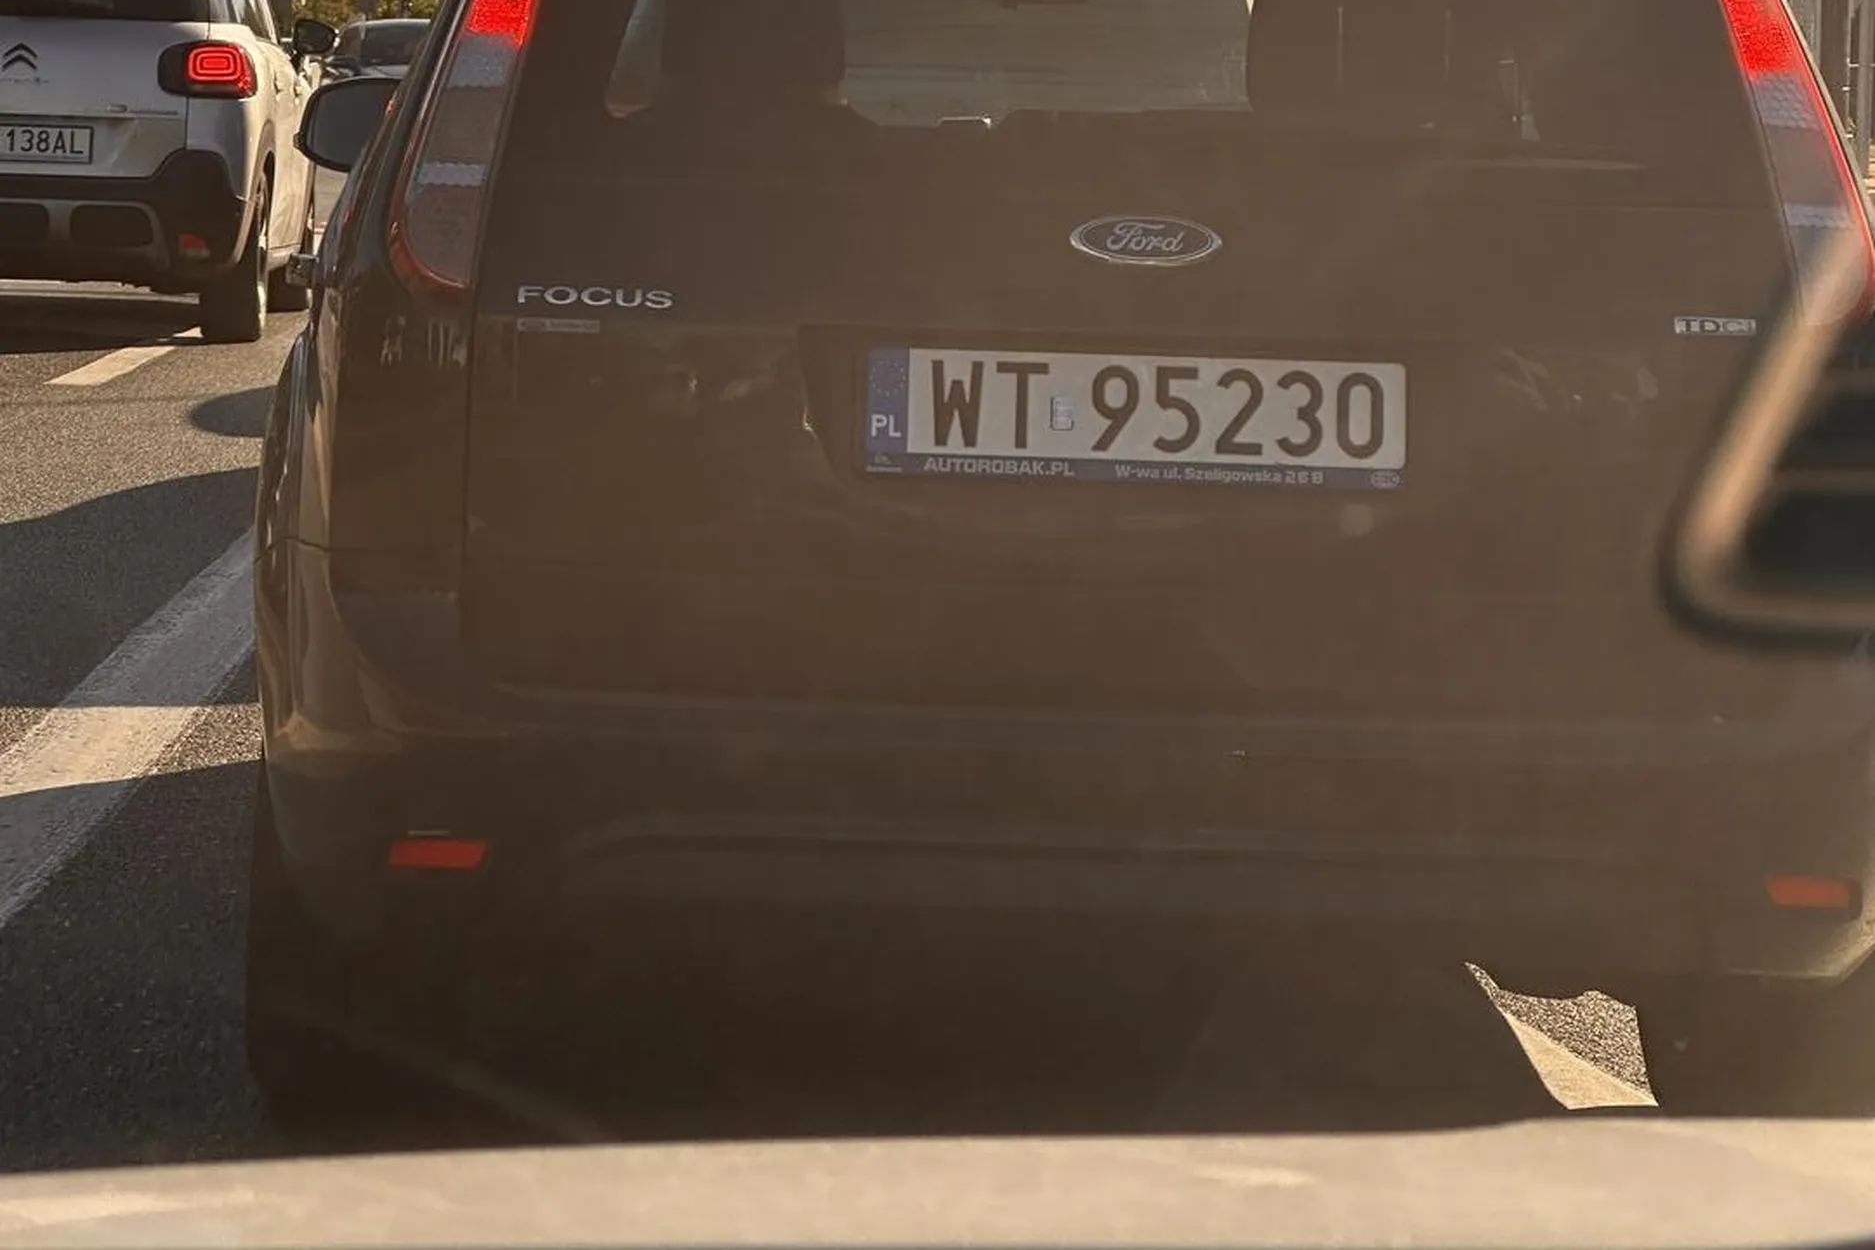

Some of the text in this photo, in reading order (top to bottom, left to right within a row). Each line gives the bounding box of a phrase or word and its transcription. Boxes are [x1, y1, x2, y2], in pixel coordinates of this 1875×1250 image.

[6, 127, 84, 155] 138AL
[1105, 221, 1184, 252] Ford
[516, 285, 673, 309] FOCUS
[931, 358, 1385, 461] WT 95230
[869, 413, 902, 438] PL
[923, 456, 1075, 477] AUTOROBAK.PL
